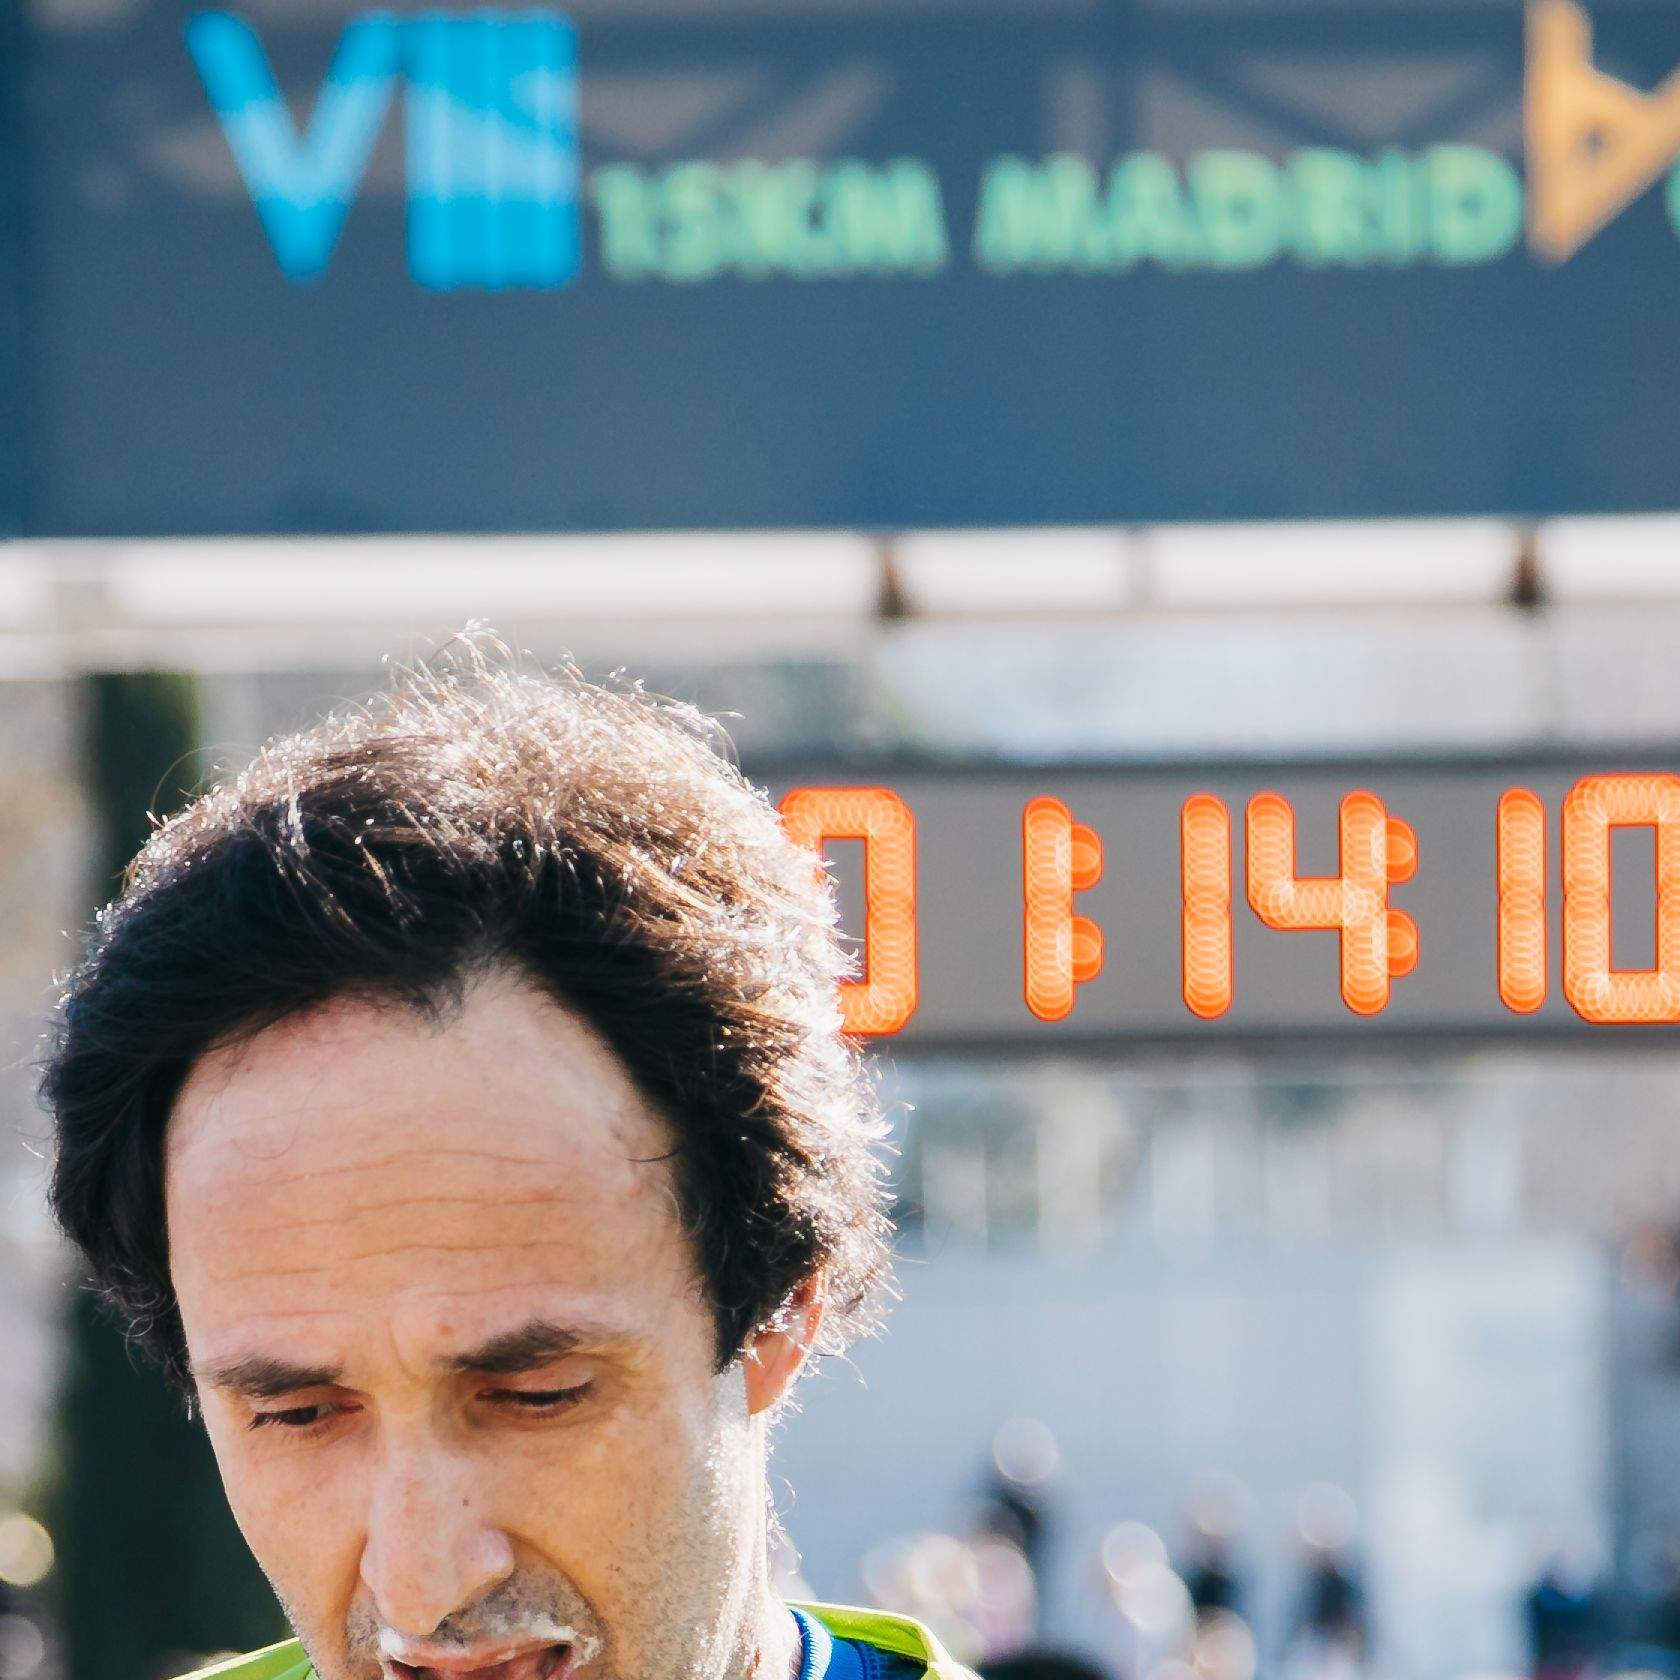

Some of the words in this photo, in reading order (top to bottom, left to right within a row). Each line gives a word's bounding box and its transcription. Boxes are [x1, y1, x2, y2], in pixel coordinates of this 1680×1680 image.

[183, 8, 583, 290] VIII
[590, 157, 950, 282] 15KM
[971, 142, 1523, 275] MADRID
